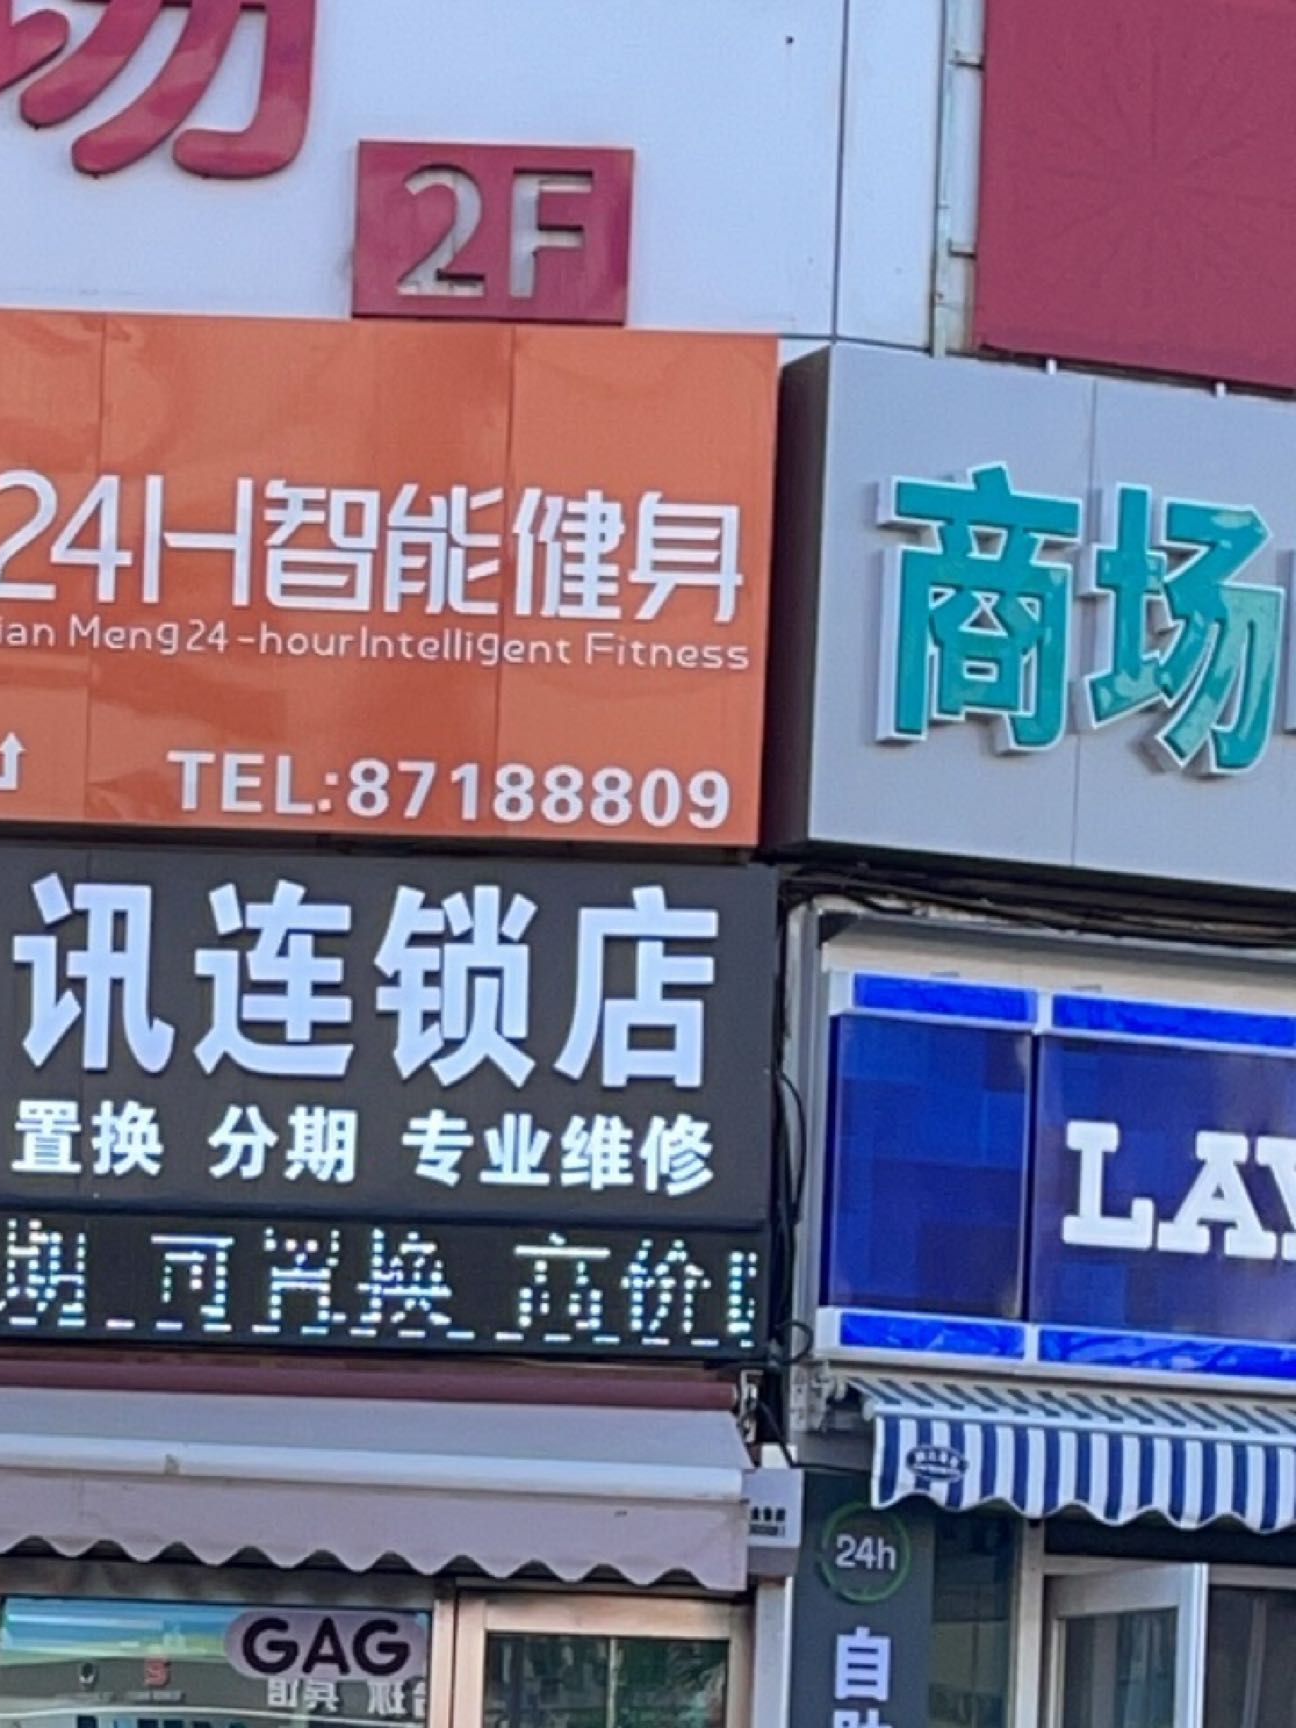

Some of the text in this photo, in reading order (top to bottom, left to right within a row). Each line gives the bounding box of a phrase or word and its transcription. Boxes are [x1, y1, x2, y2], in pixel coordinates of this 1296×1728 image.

[396, 163, 594, 299] 2F
[585, 632, 749, 670] Fitness
[12, 1100, 163, 1176] 置换
[208, 1104, 359, 1184] 分期
[402, 1109, 714, 1197] 专业维修
[836, 1534, 895, 1571] 24h
[242, 1617, 410, 1676] GAG
